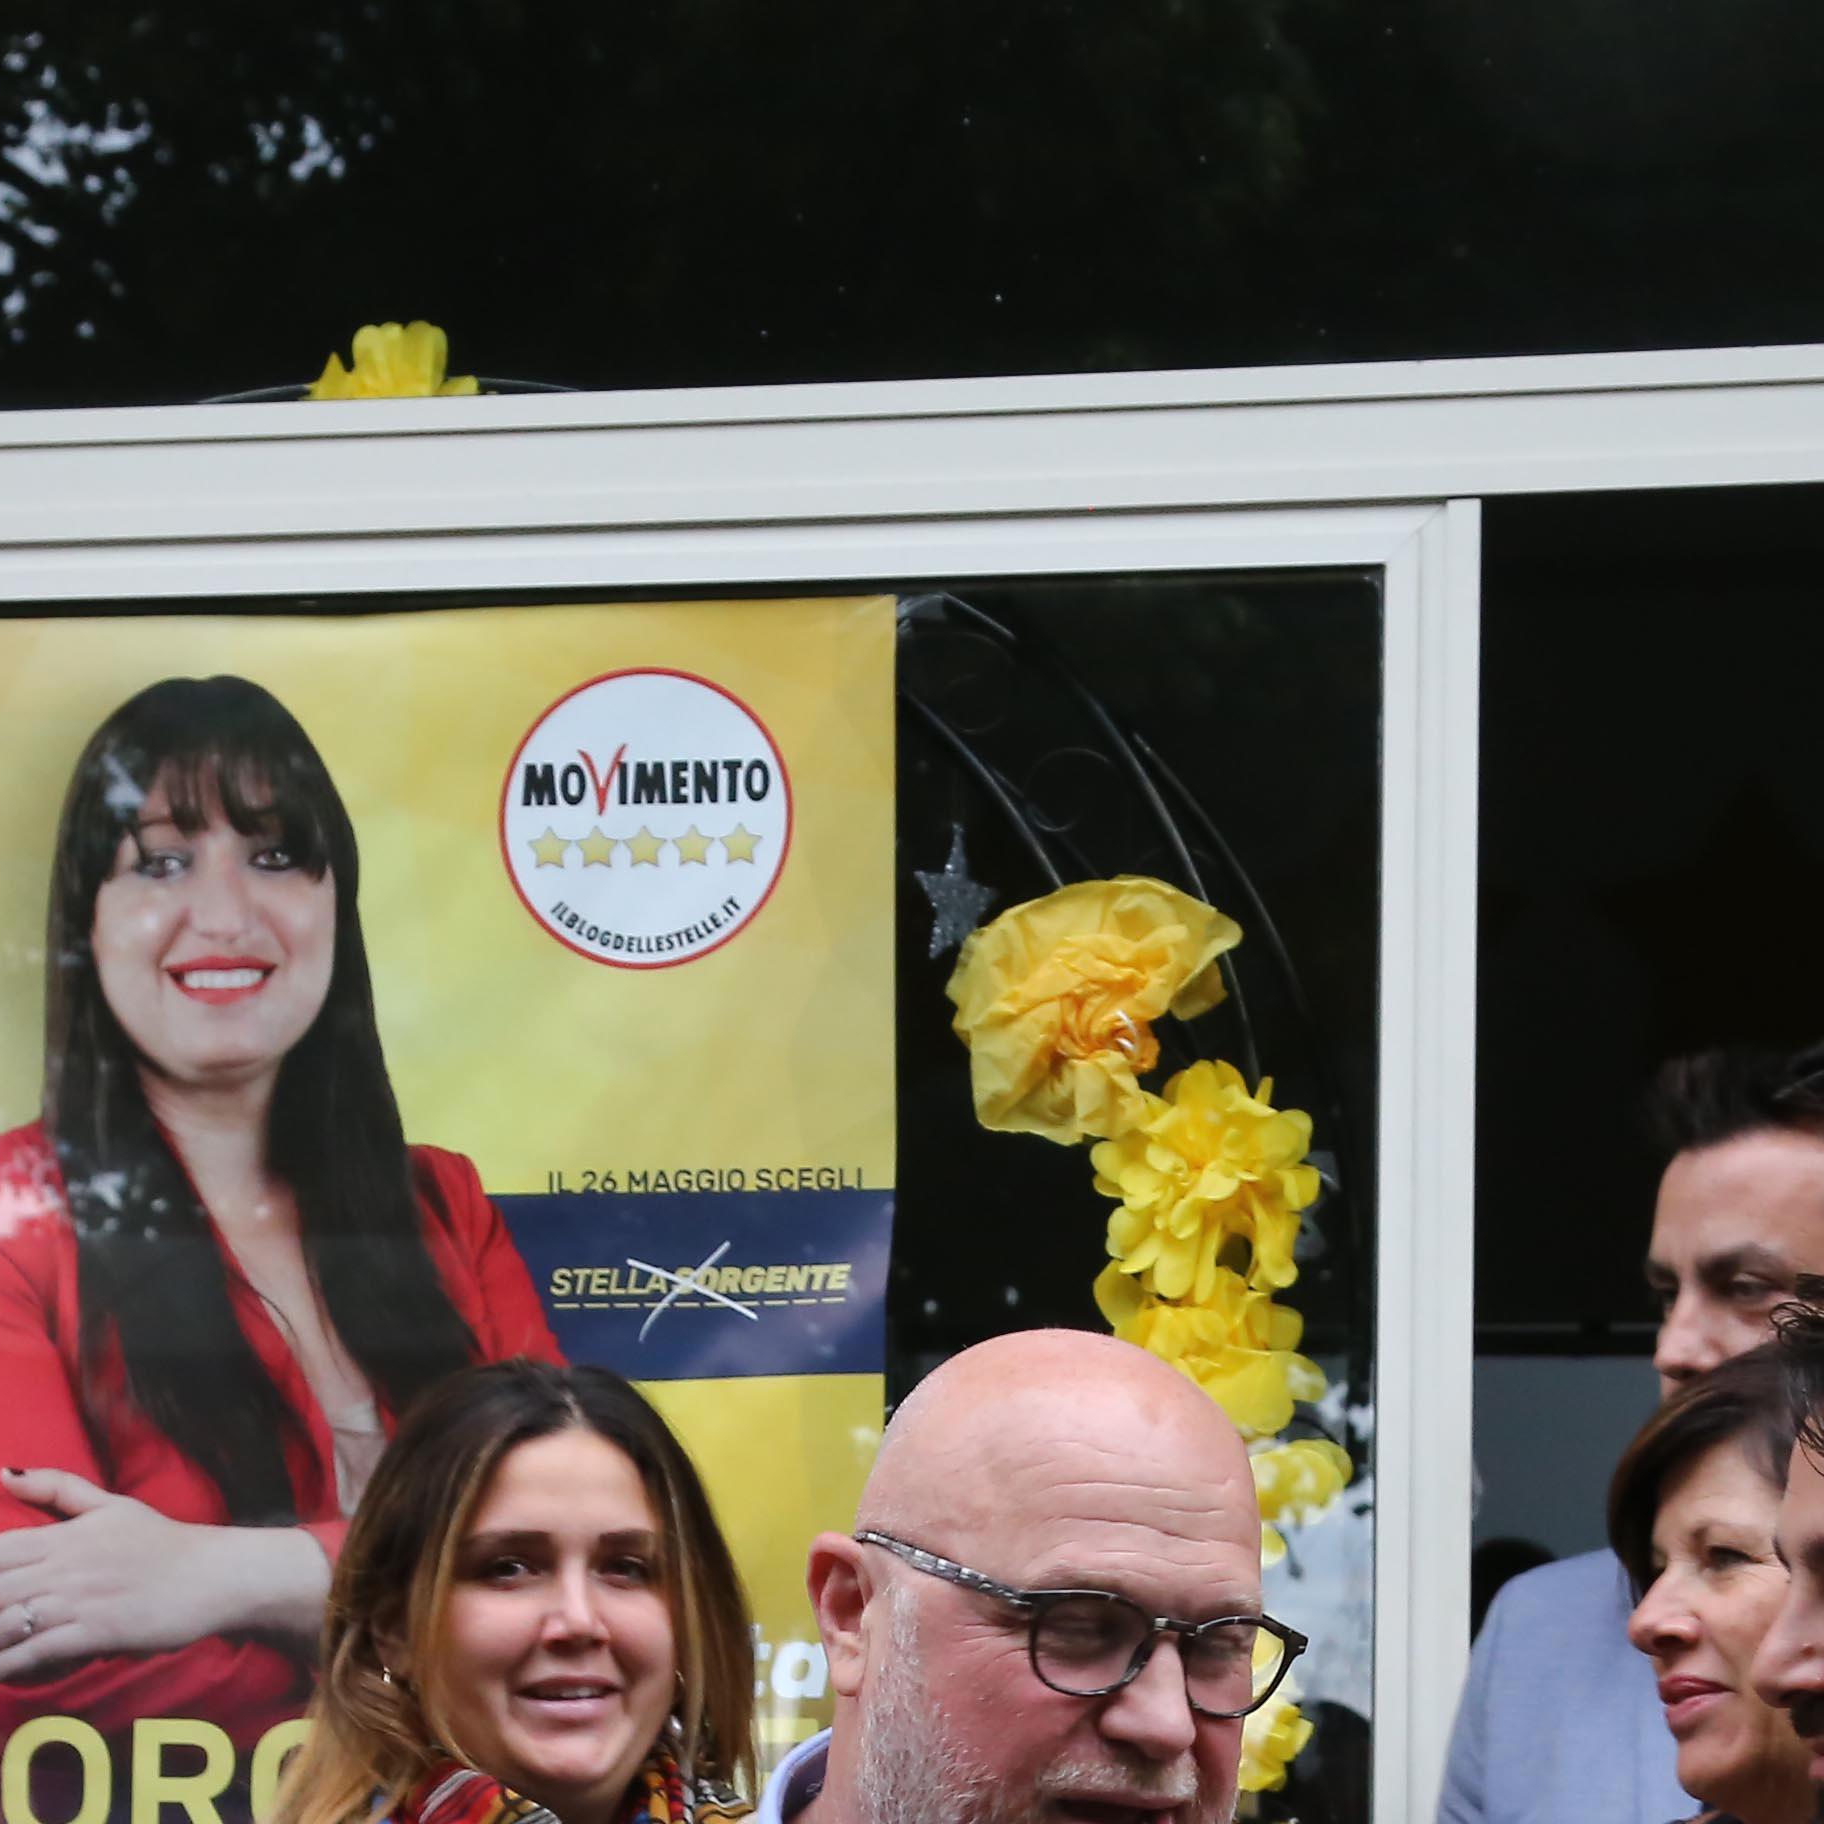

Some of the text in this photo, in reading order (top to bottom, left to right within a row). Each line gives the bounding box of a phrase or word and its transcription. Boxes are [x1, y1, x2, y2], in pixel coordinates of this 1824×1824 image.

[522, 743, 771, 816] MOVIMENTO
[550, 896, 742, 954] ILBLOGDELLESTELLE.IT
[548, 1167, 863, 1194] IL 26 MAGGIO SCEGLI
[549, 1263, 852, 1297] STELLA SORGENTE
